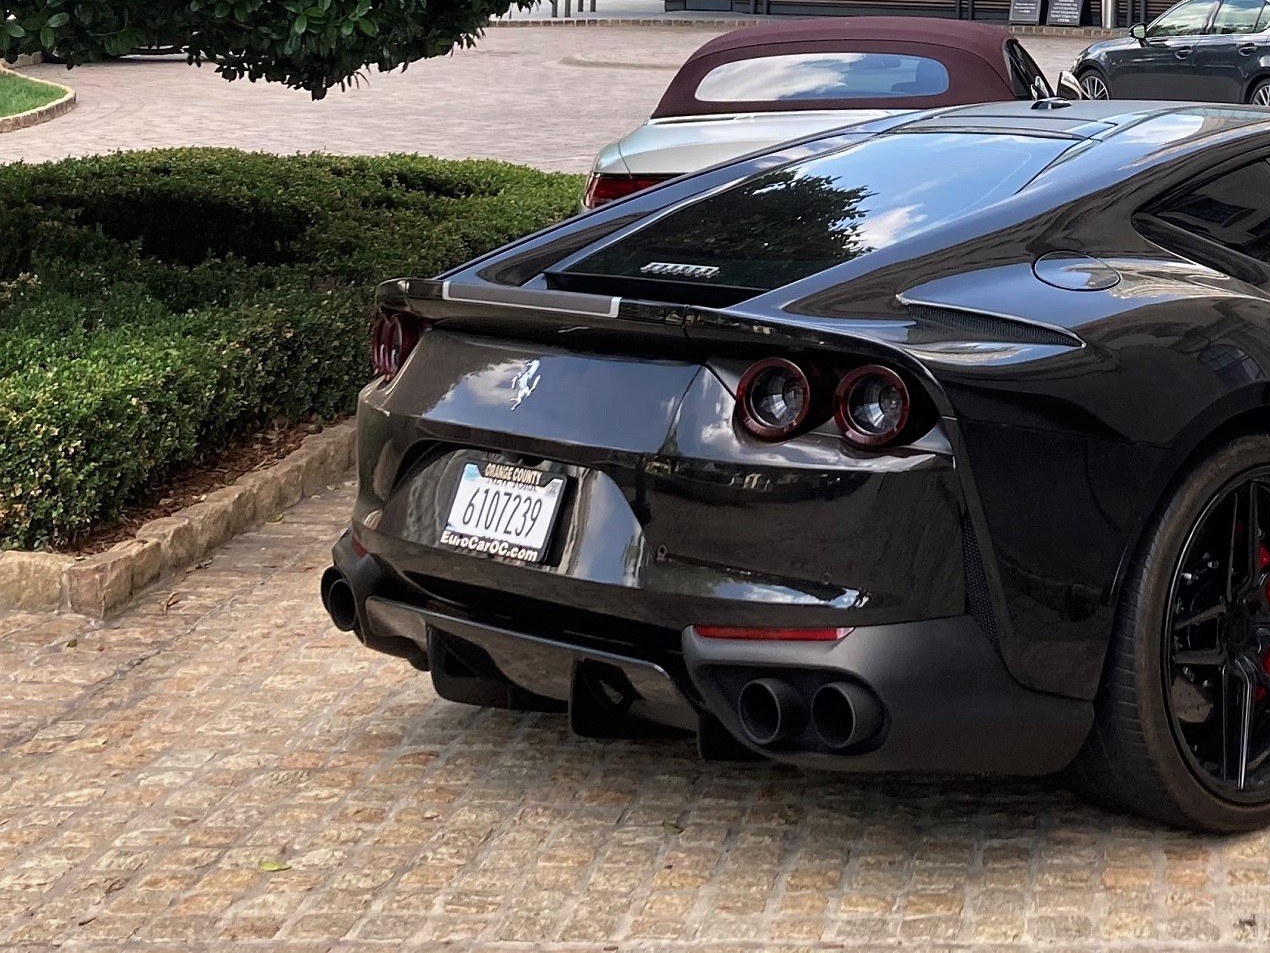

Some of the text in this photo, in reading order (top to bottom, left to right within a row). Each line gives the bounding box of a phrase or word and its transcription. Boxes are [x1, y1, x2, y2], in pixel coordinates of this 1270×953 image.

[484, 463, 543, 485] ORANGE COUNTY
[462, 488, 543, 538] 6107239
[440, 530, 538, 562] EuroCarOC.com
